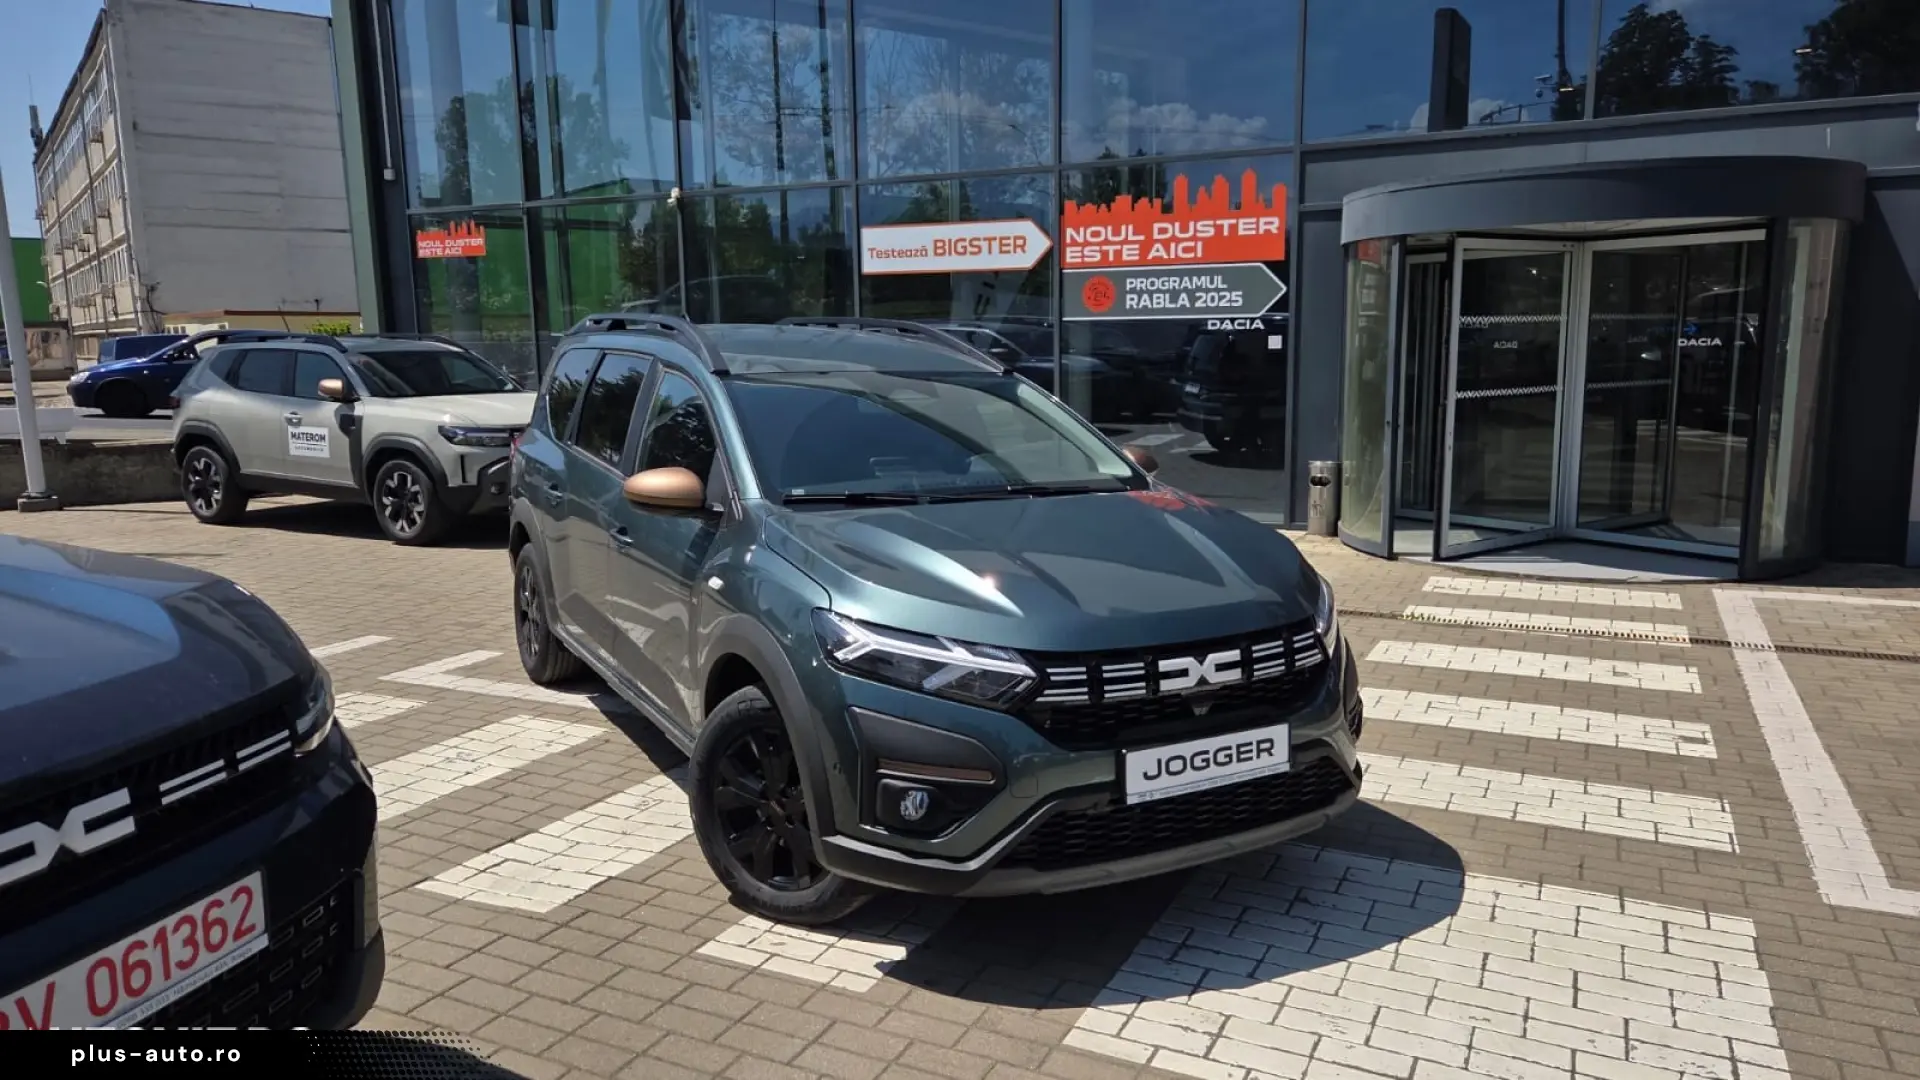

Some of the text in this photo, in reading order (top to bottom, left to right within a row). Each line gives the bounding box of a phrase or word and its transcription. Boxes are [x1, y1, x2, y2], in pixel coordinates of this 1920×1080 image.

[1066, 217, 1280, 244] NOUL DUSTER
[418, 247, 462, 257] ESTE AICI
[419, 238, 484, 249] NOUL DUSTER
[868, 235, 1028, 260] Testează BIGSTER
[1065, 241, 1203, 263] ESTE AICI
[1126, 275, 1228, 291] PROGRAMUL
[1126, 293, 1191, 309] RABLA
[1194, 291, 1243, 308] 2025
[1207, 319, 1266, 330] DACIA
[1678, 338, 1722, 347] DACIA
[290, 431, 326, 442] MATEROM
[1142, 738, 1275, 781] JOGGER
[86, 885, 257, 1018] 061362
